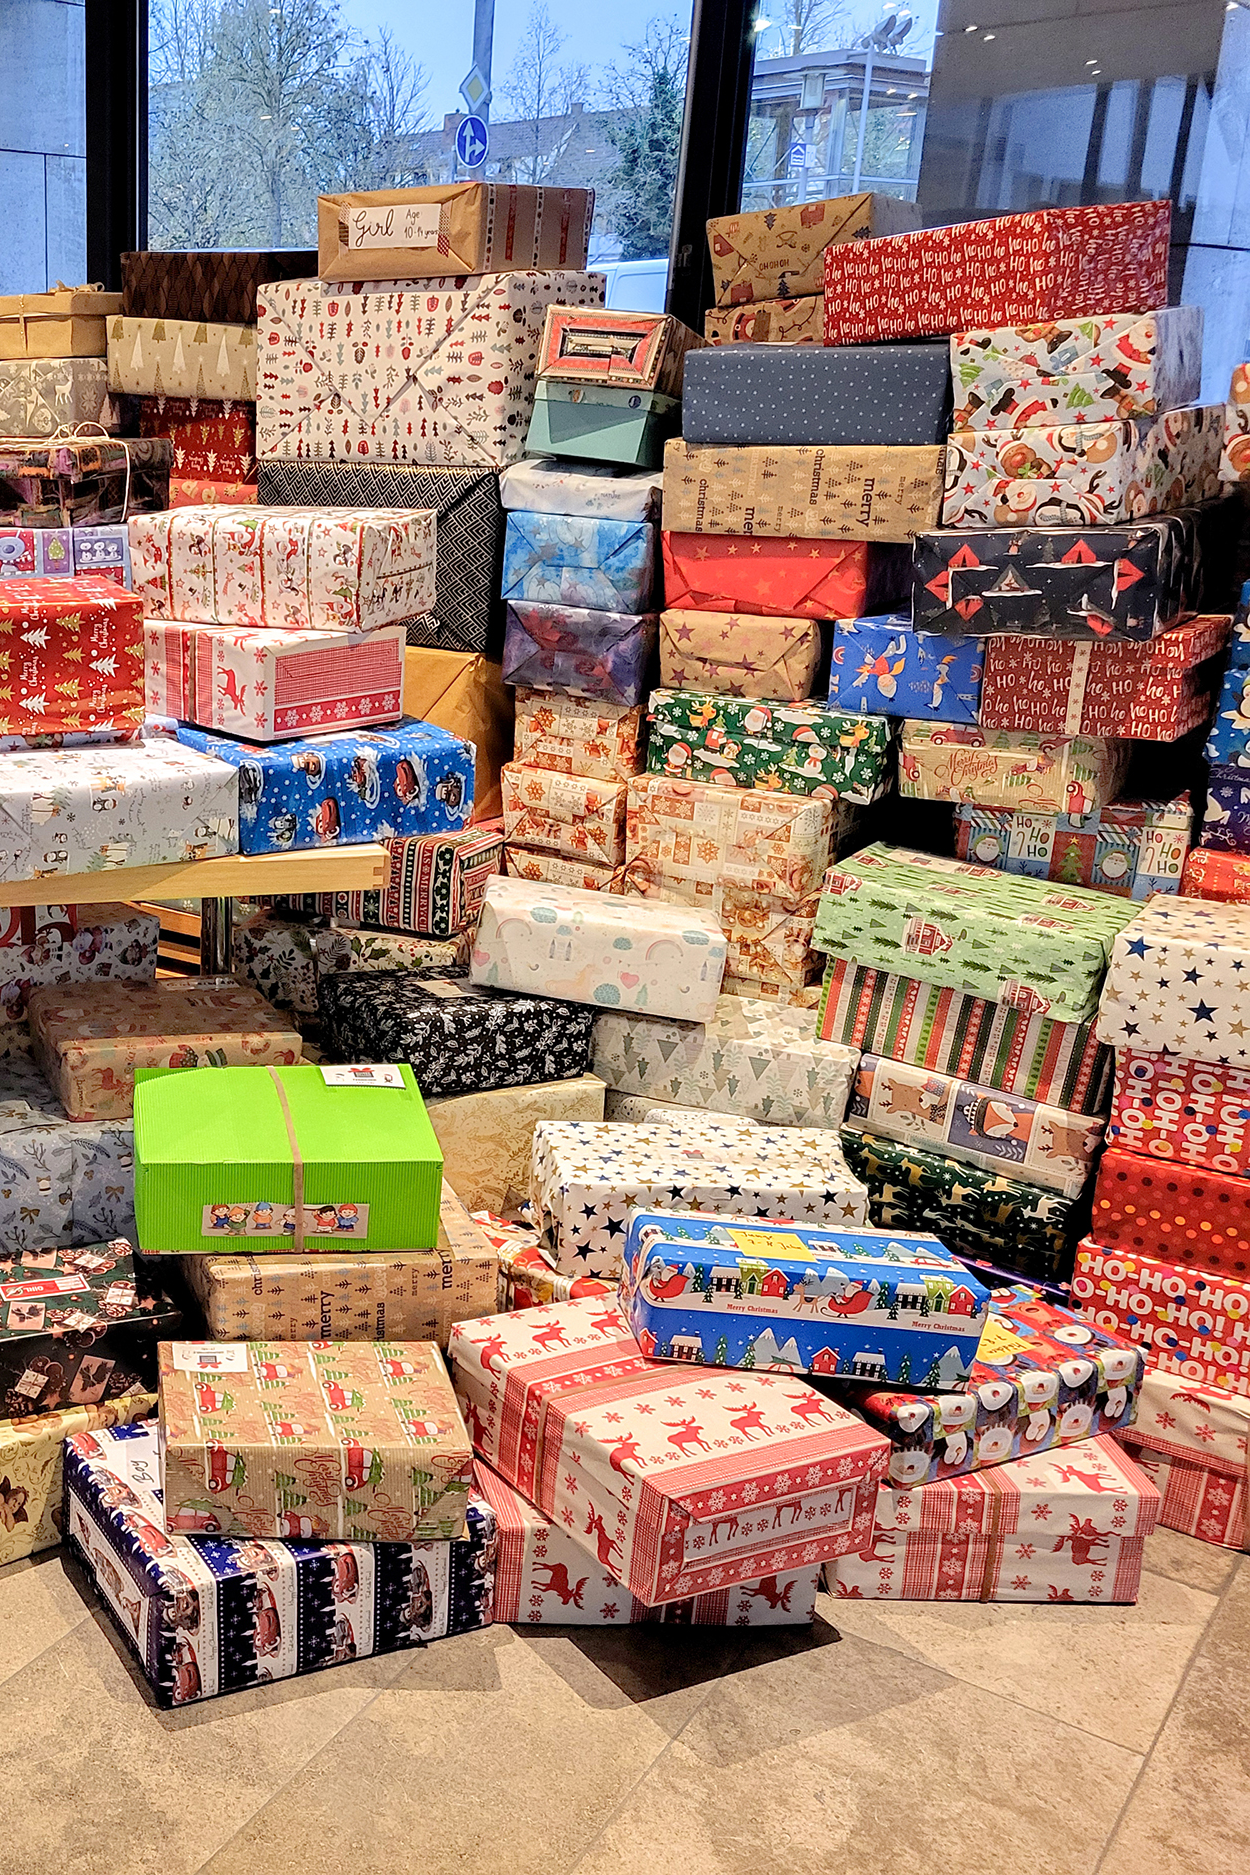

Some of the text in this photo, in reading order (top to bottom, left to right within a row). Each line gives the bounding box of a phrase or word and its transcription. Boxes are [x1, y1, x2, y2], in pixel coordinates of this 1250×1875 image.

[353, 209, 394, 247] Girl
[832, 232, 1055, 281] ho ho HO ho ho HO ho ho HO ho ho HO ho ho HO ho
[828, 274, 1054, 315] HO ho HO ho HO ho HO ho HO ho HO
[809, 449, 824, 505] christmas
[696, 478, 709, 532] christmas
[856, 477, 876, 527] merry
[90, 623, 100, 643] Merry
[100, 618, 109, 649] Christmas
[20, 661, 30, 681] Merry
[29, 656, 38, 687] Christmas
[997, 674, 1015, 688] HO
[1027, 672, 1045, 692] ho
[1086, 675, 1103, 694] ho
[1112, 680, 1132, 695] HO
[1146, 678, 1163, 697] ho
[995, 694, 1166, 722] ho ho HO ho HO ho ho HO
[983, 714, 1174, 740] ho HO ho ho HO ho
[1016, 816, 1032, 829] HO
[1030, 826, 1050, 843] HO
[1146, 830, 1163, 844] HO
[1027, 846, 1048, 858] HO
[1161, 843, 1181, 860] HO
[1158, 861, 1179, 874] HO
[420, 874, 430, 912] MERRY
[320, 1290, 335, 1339] merry
[726, 1303, 778, 1314] Merry Christmas
[912, 1321, 966, 1332] Merry Christmas
[130, 1460, 154, 1483] Boy
